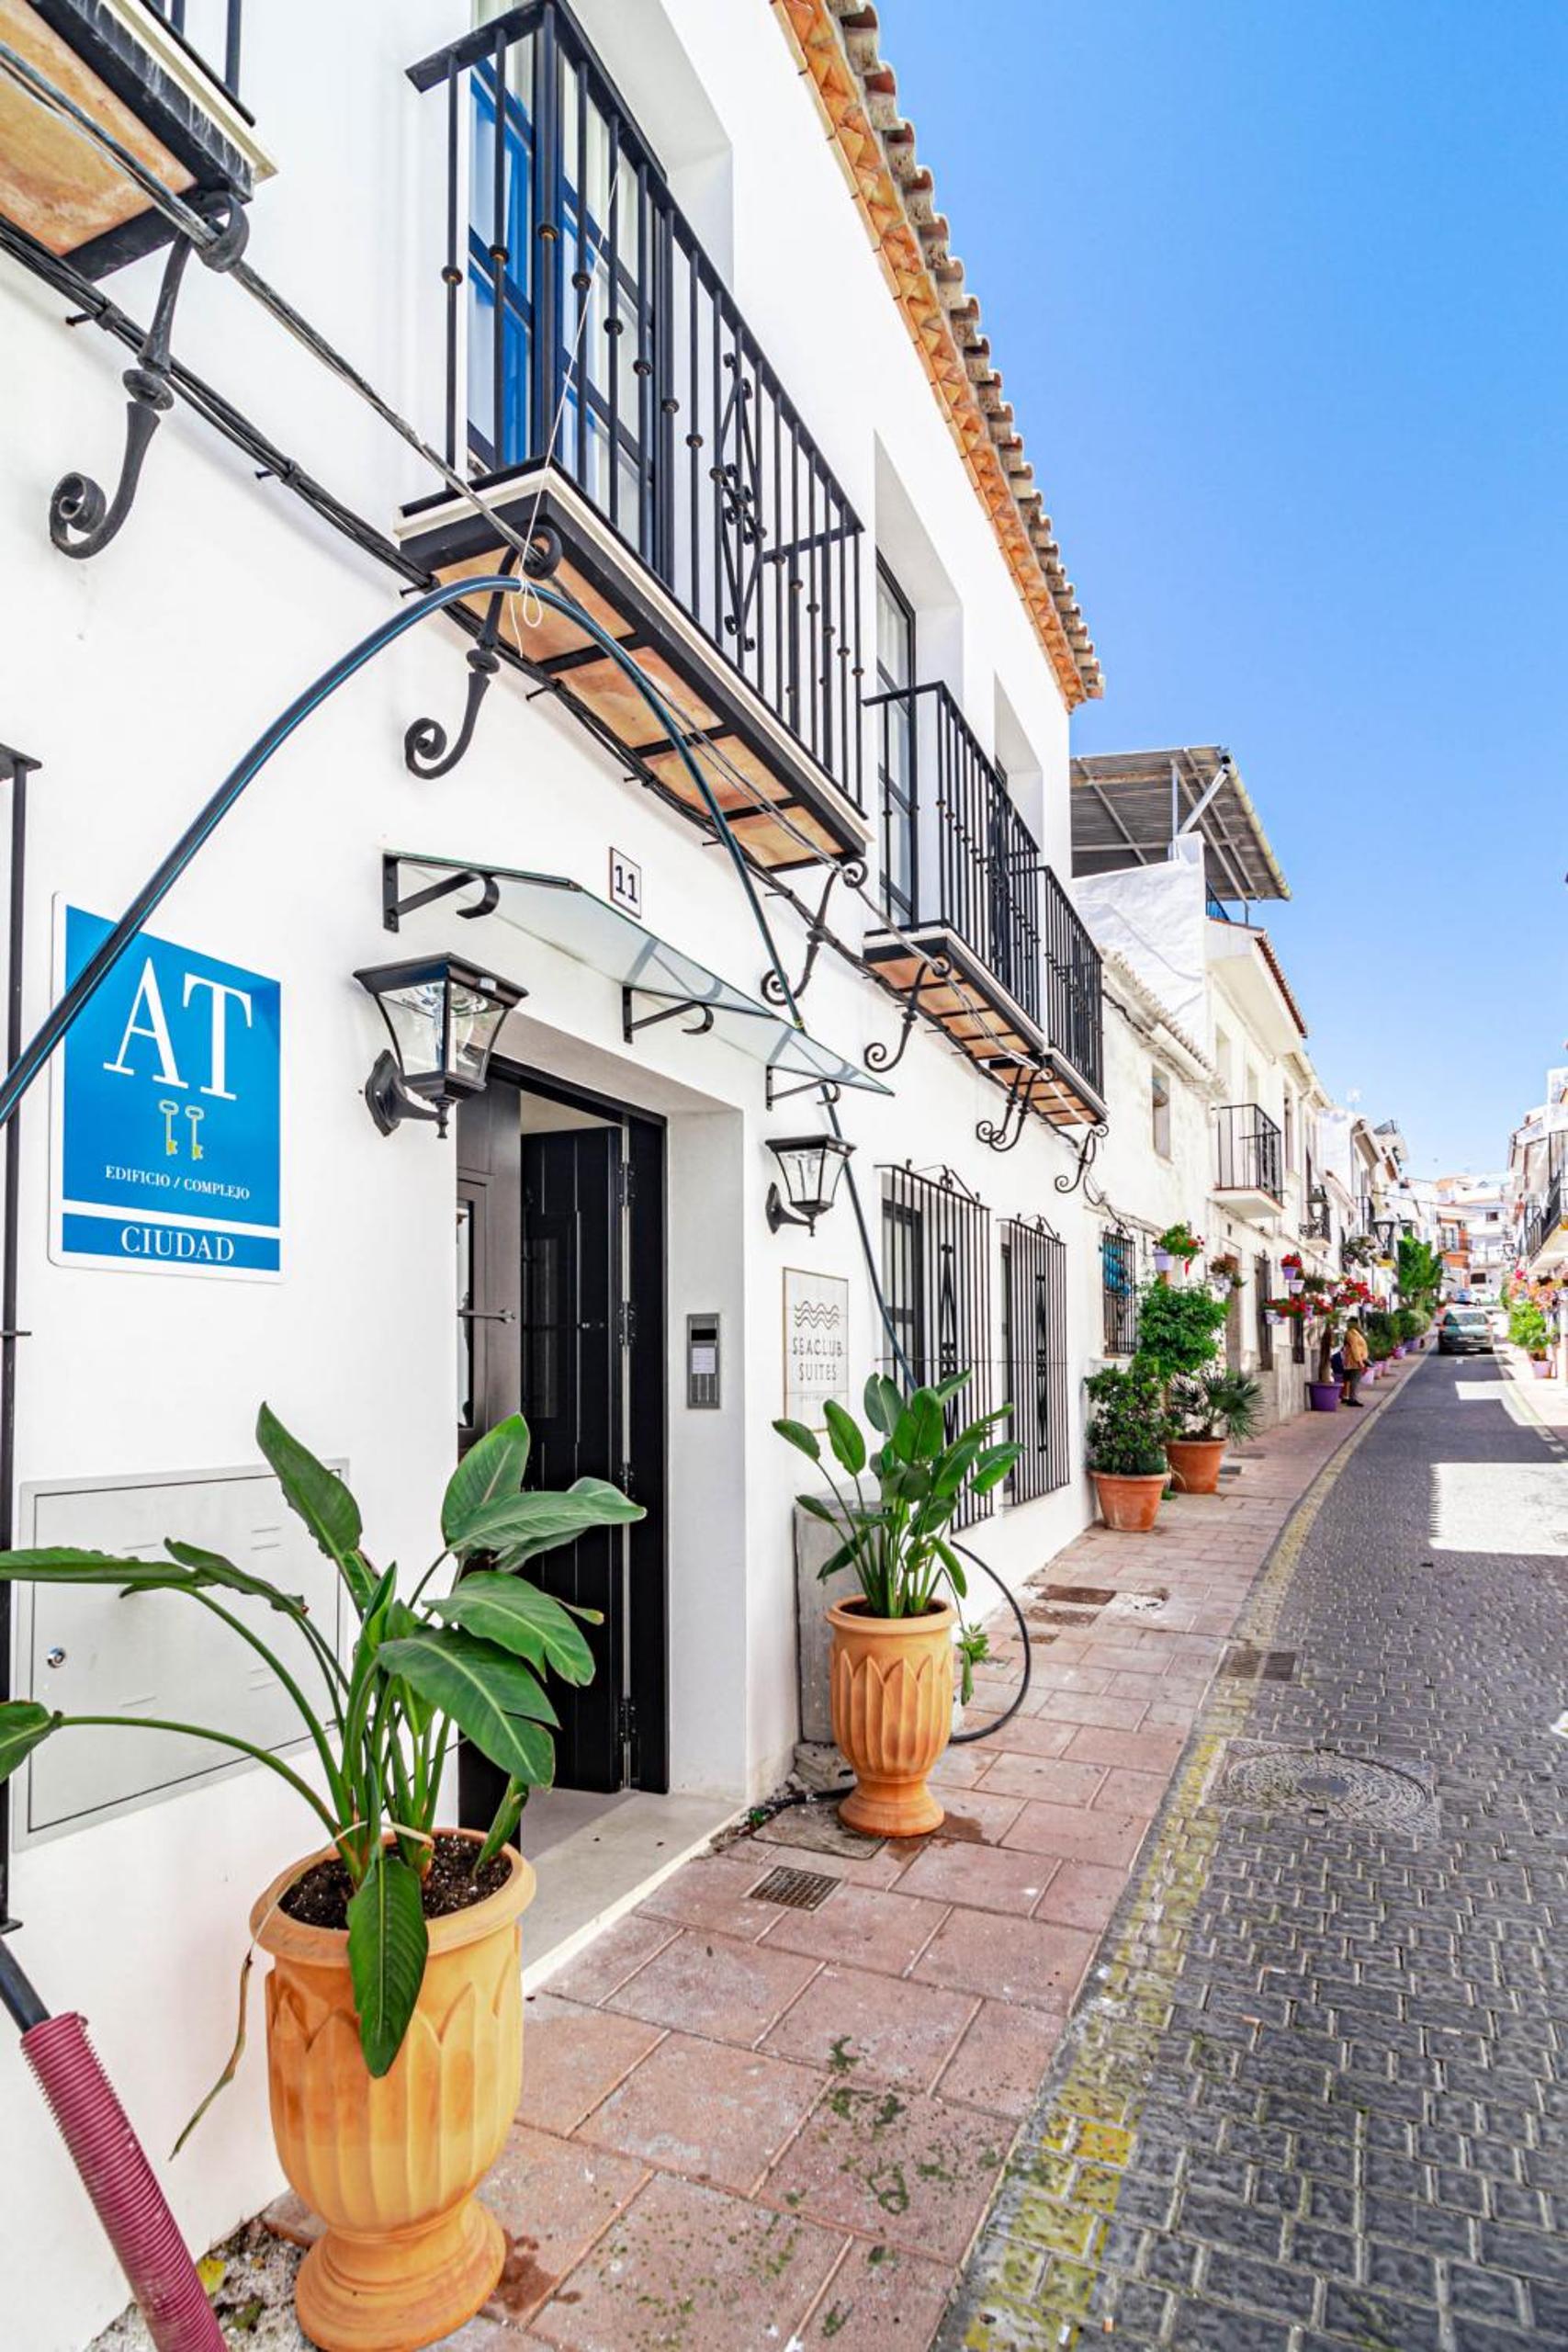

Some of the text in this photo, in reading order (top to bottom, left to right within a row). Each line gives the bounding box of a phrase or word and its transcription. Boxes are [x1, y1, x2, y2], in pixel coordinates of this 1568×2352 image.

[615, 865, 638, 903] 11
[103, 956, 252, 1100] AT
[105, 1165, 171, 1189] EDIFICIO
[184, 1178, 250, 1200] COMPLEJO
[120, 1226, 234, 1262] CIUDAD
[793, 1337, 842, 1356] SEACLUB
[798, 1363, 837, 1381] SUITES
